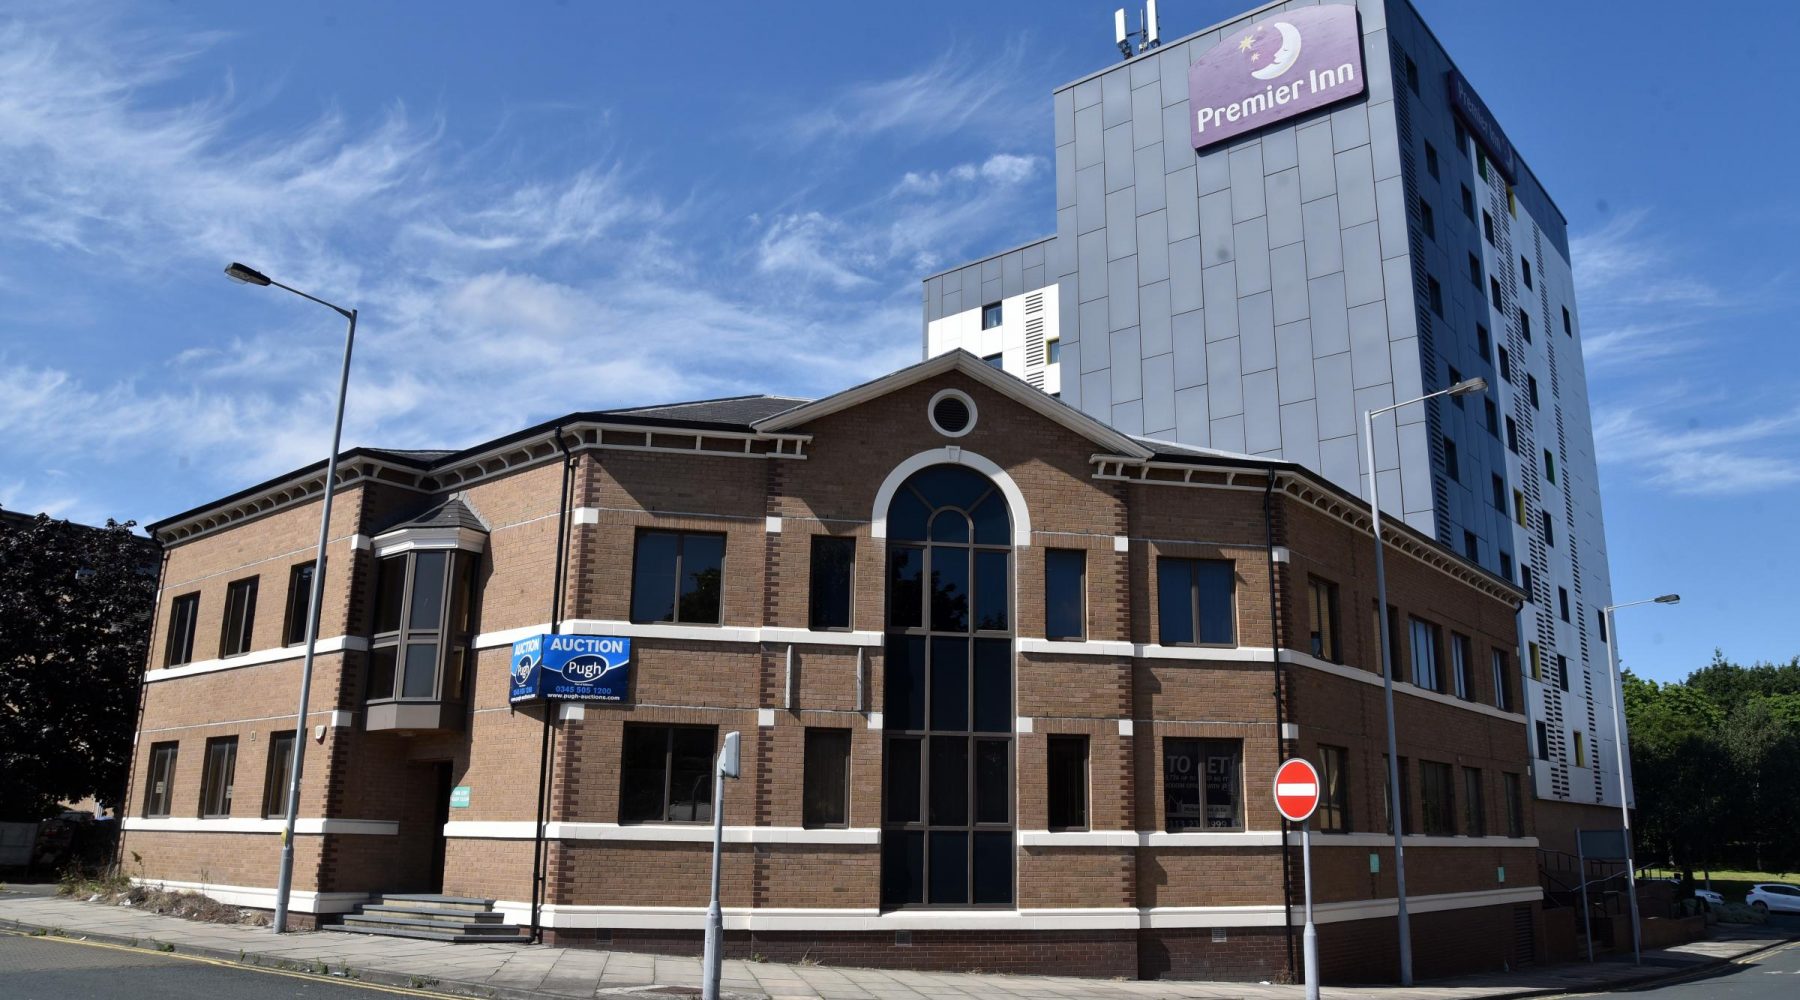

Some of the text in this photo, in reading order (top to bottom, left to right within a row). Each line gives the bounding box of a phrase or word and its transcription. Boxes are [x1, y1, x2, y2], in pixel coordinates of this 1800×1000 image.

[1197, 63, 1354, 133] Premier Inn
[514, 638, 540, 656] AUCTION
[550, 637, 623, 653] AUCTION
[517, 662, 530, 679] Pugh
[568, 661, 602, 678] Pugh
[547, 693, 621, 701] www.pugh-auctions.com
[555, 685, 575, 693] 0345
[593, 687, 612, 695] 1200
[1167, 755, 1192, 774] TO
